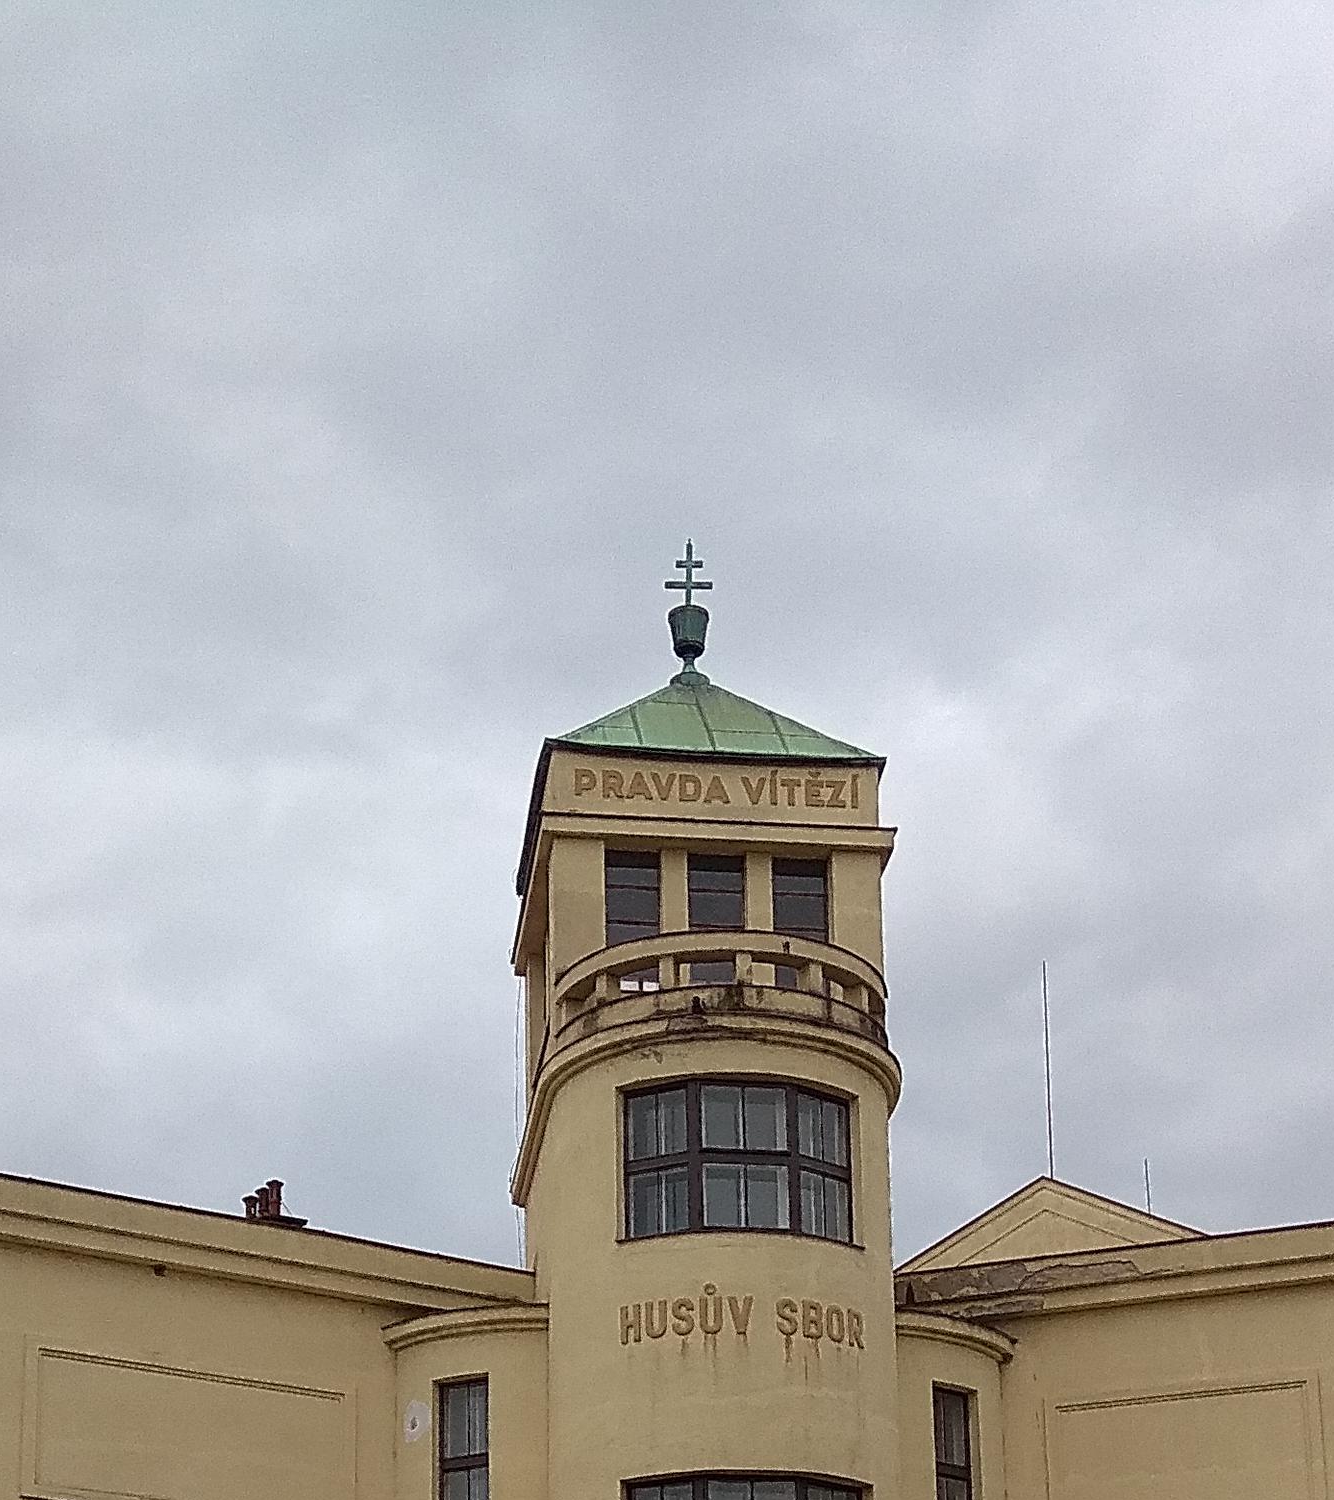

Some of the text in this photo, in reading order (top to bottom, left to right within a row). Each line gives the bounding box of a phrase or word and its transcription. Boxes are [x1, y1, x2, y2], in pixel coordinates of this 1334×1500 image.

[573, 768, 860, 809] PRAVDA VÍTĚZÍ
[619, 1281, 865, 1350] HUSŮV SBOR
